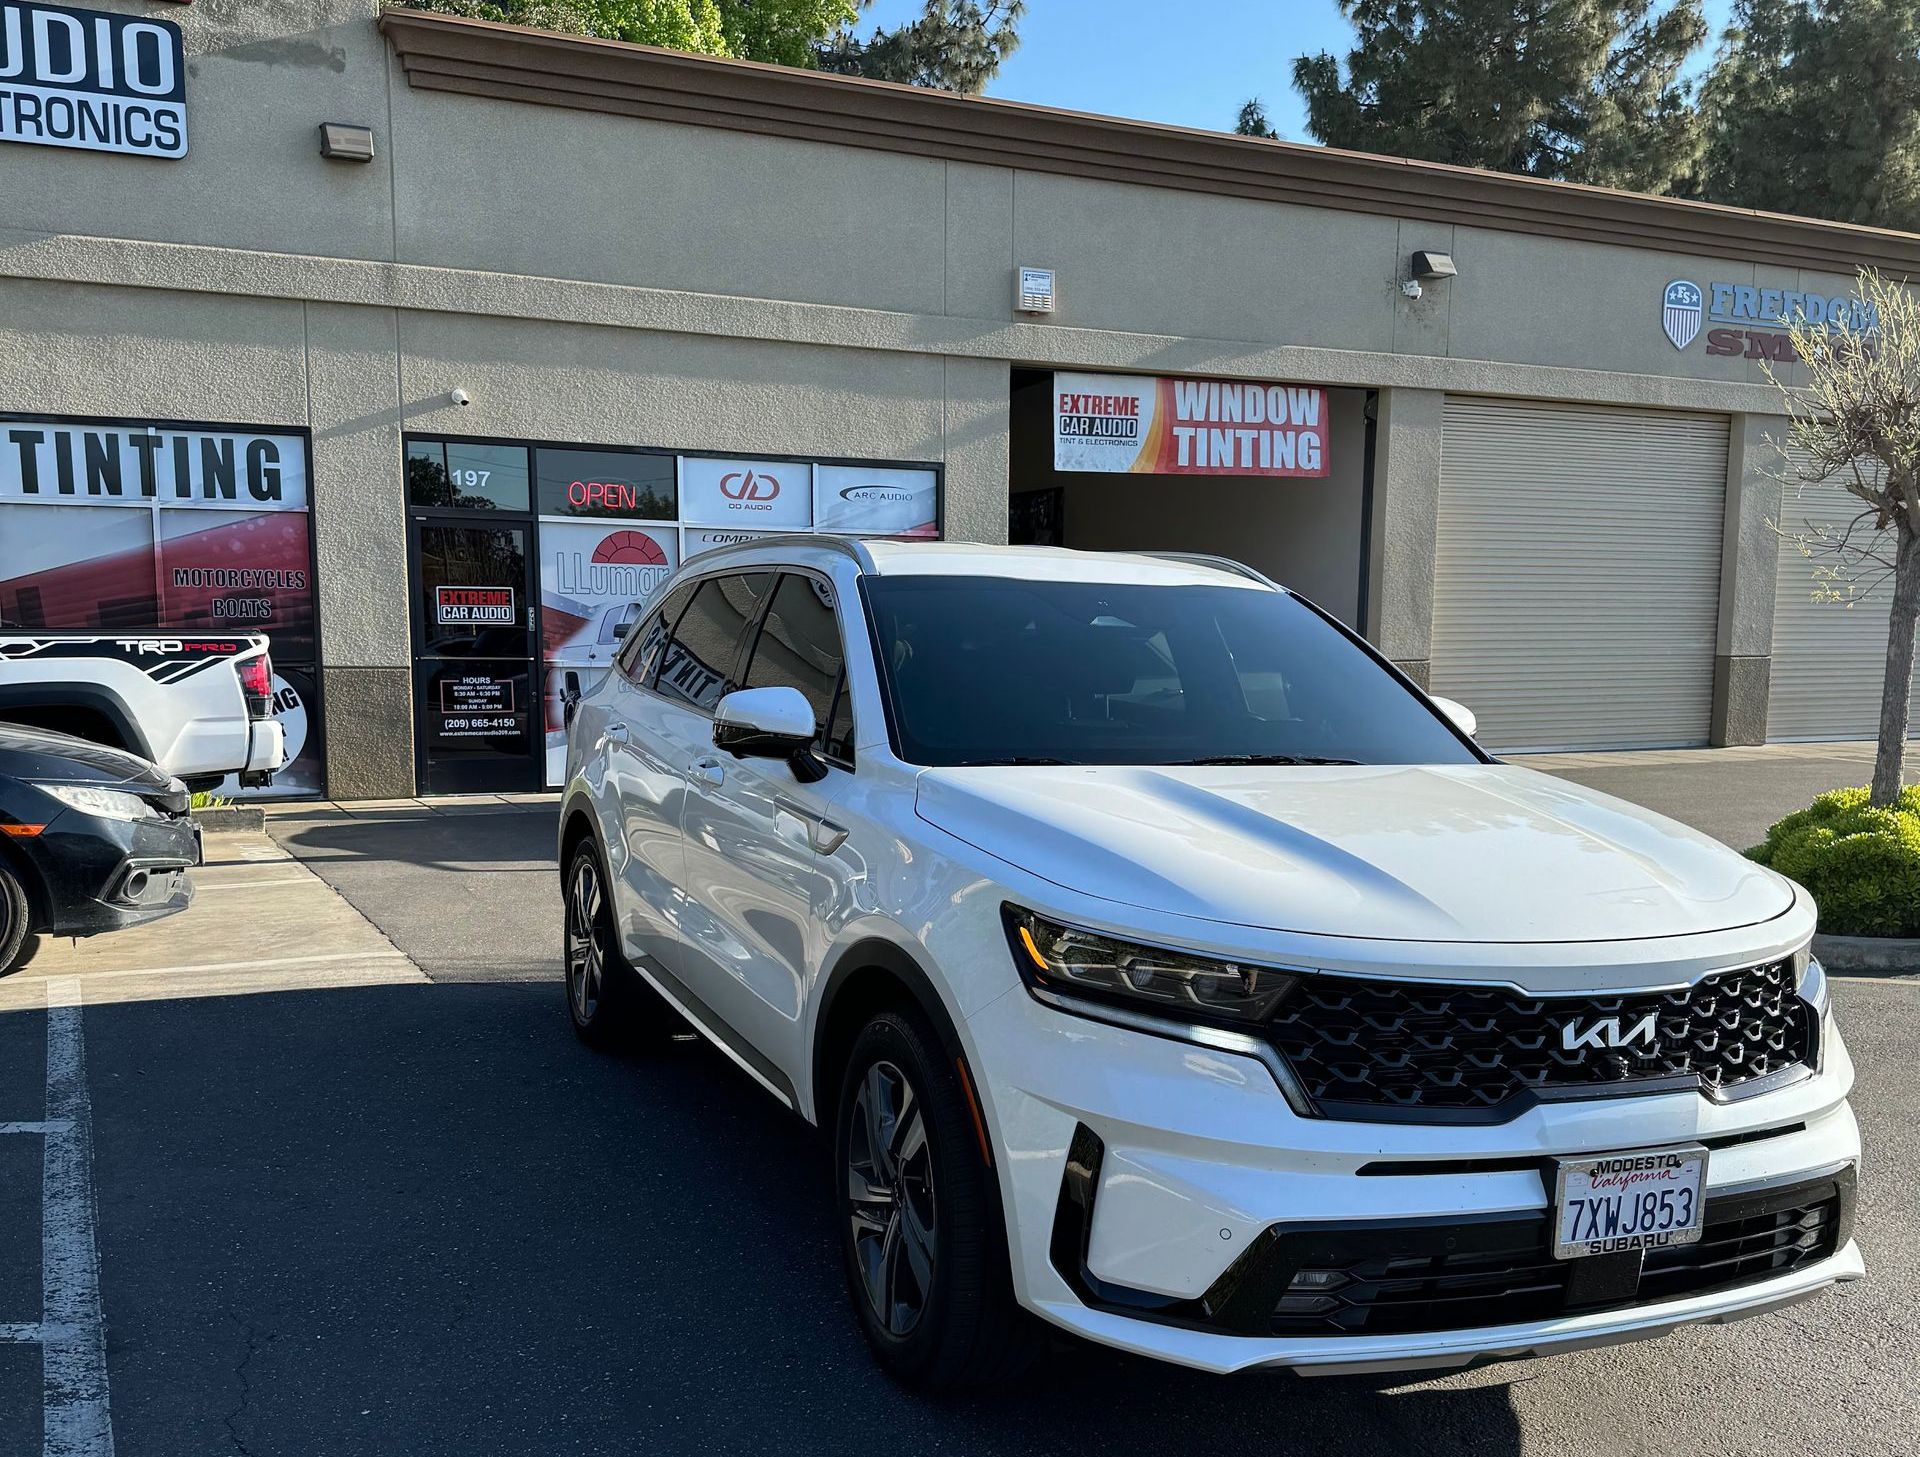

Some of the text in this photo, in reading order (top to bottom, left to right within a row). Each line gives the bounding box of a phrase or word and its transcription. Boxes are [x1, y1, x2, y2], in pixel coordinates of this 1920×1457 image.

[1706, 328, 1878, 365] SMG
[1059, 393, 1139, 417] EXTREME
[1174, 380, 1321, 427] WINDOW
[1060, 416, 1137, 438] CAR AUDIO
[1059, 437, 1077, 445] TINT
[1085, 438, 1138, 447] ELECTRONICS
[1172, 426, 1322, 471] TINTING
[9, 429, 283, 501] TINTING
[452, 469, 491, 487] 197
[567, 481, 636, 509] OPEN
[854, 491, 913, 501] ARC AUDIO
[744, 503, 773, 511] AUDIO
[173, 568, 306, 590] MOTORCYCLES
[440, 589, 511, 606] EXTREME
[213, 598, 272, 619] BOATS
[442, 606, 511, 620] CAR AUDIO
[115, 640, 238, 656] TRD PRO
[462, 676, 491, 684] HOURS
[444, 718, 515, 730] (209) 665-4150
[1596, 1153, 1678, 1174] MODESTO
[1591, 1169, 1679, 1192] California
[1568, 1187, 1693, 1241] 7XWJ853
